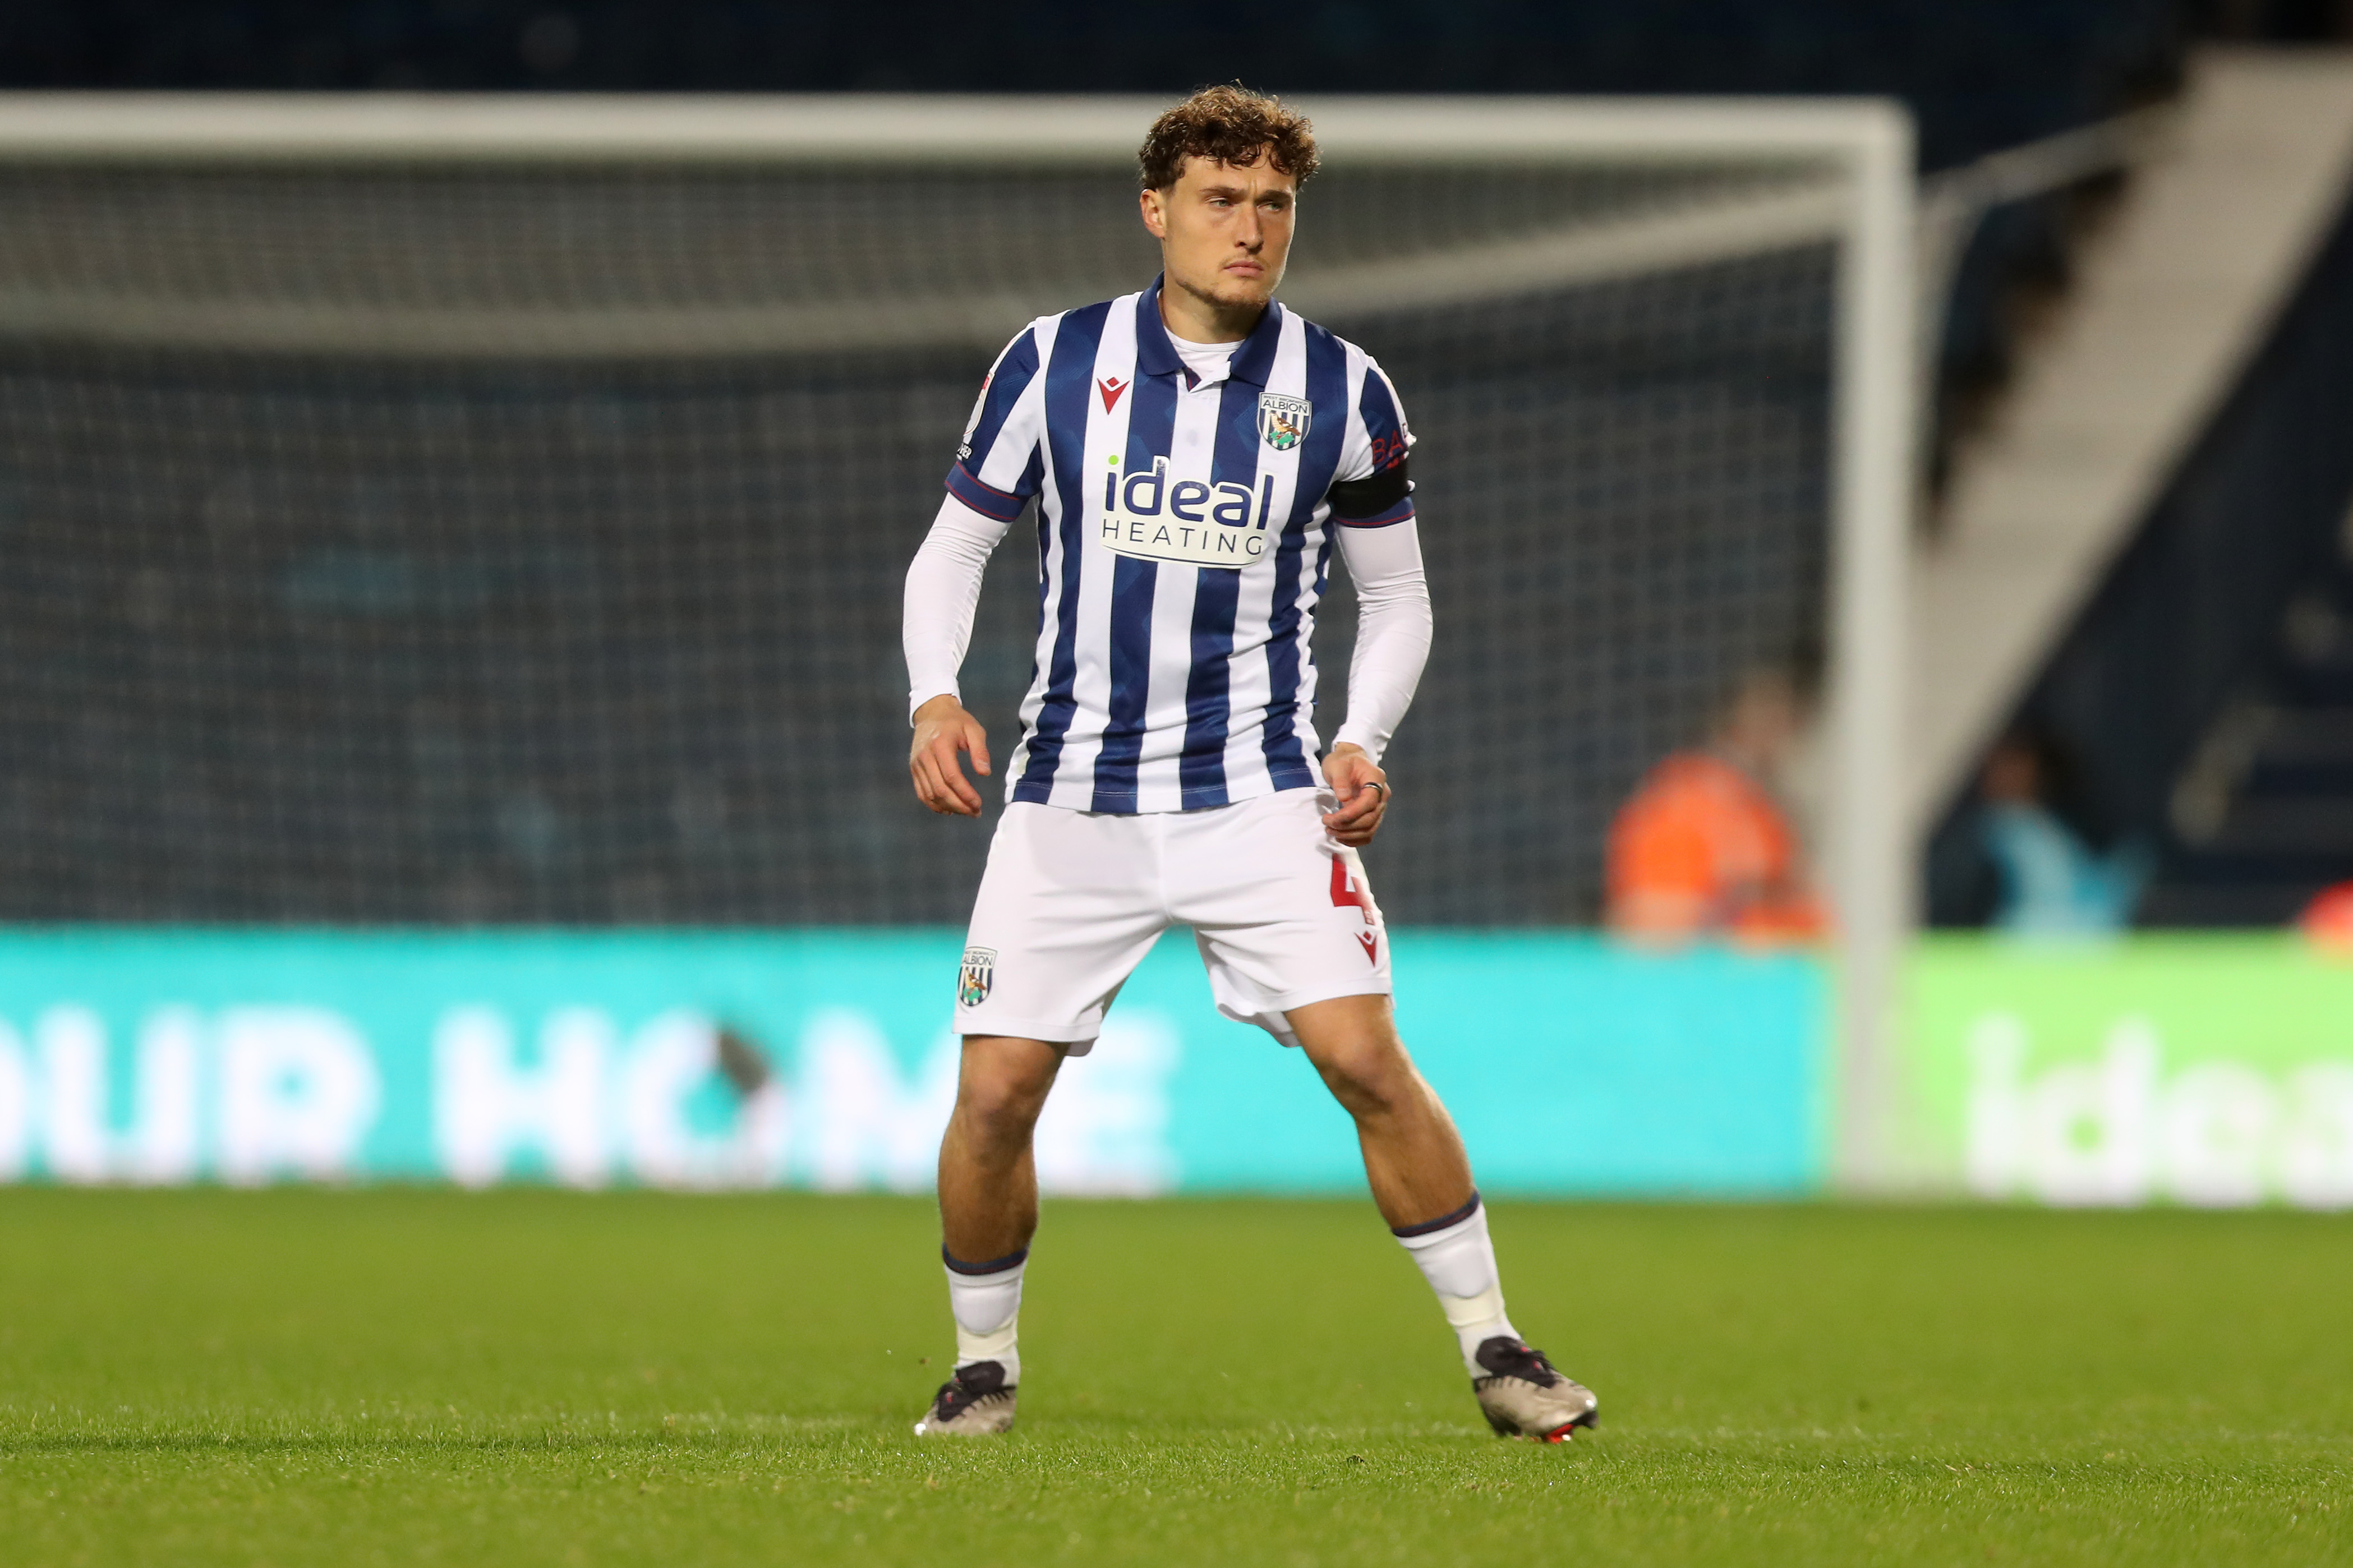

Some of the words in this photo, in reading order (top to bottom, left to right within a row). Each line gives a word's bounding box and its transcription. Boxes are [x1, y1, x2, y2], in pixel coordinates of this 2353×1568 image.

[1263, 399, 1308, 414] ALBION
[1106, 455, 1274, 531] ideal
[1102, 519, 1263, 556] HEATING
[1330, 852, 1375, 926] 4
[963, 955, 993, 966] ALBION
[0, 1004, 383, 1188] UR
[431, 1006, 1180, 1196] HOME
